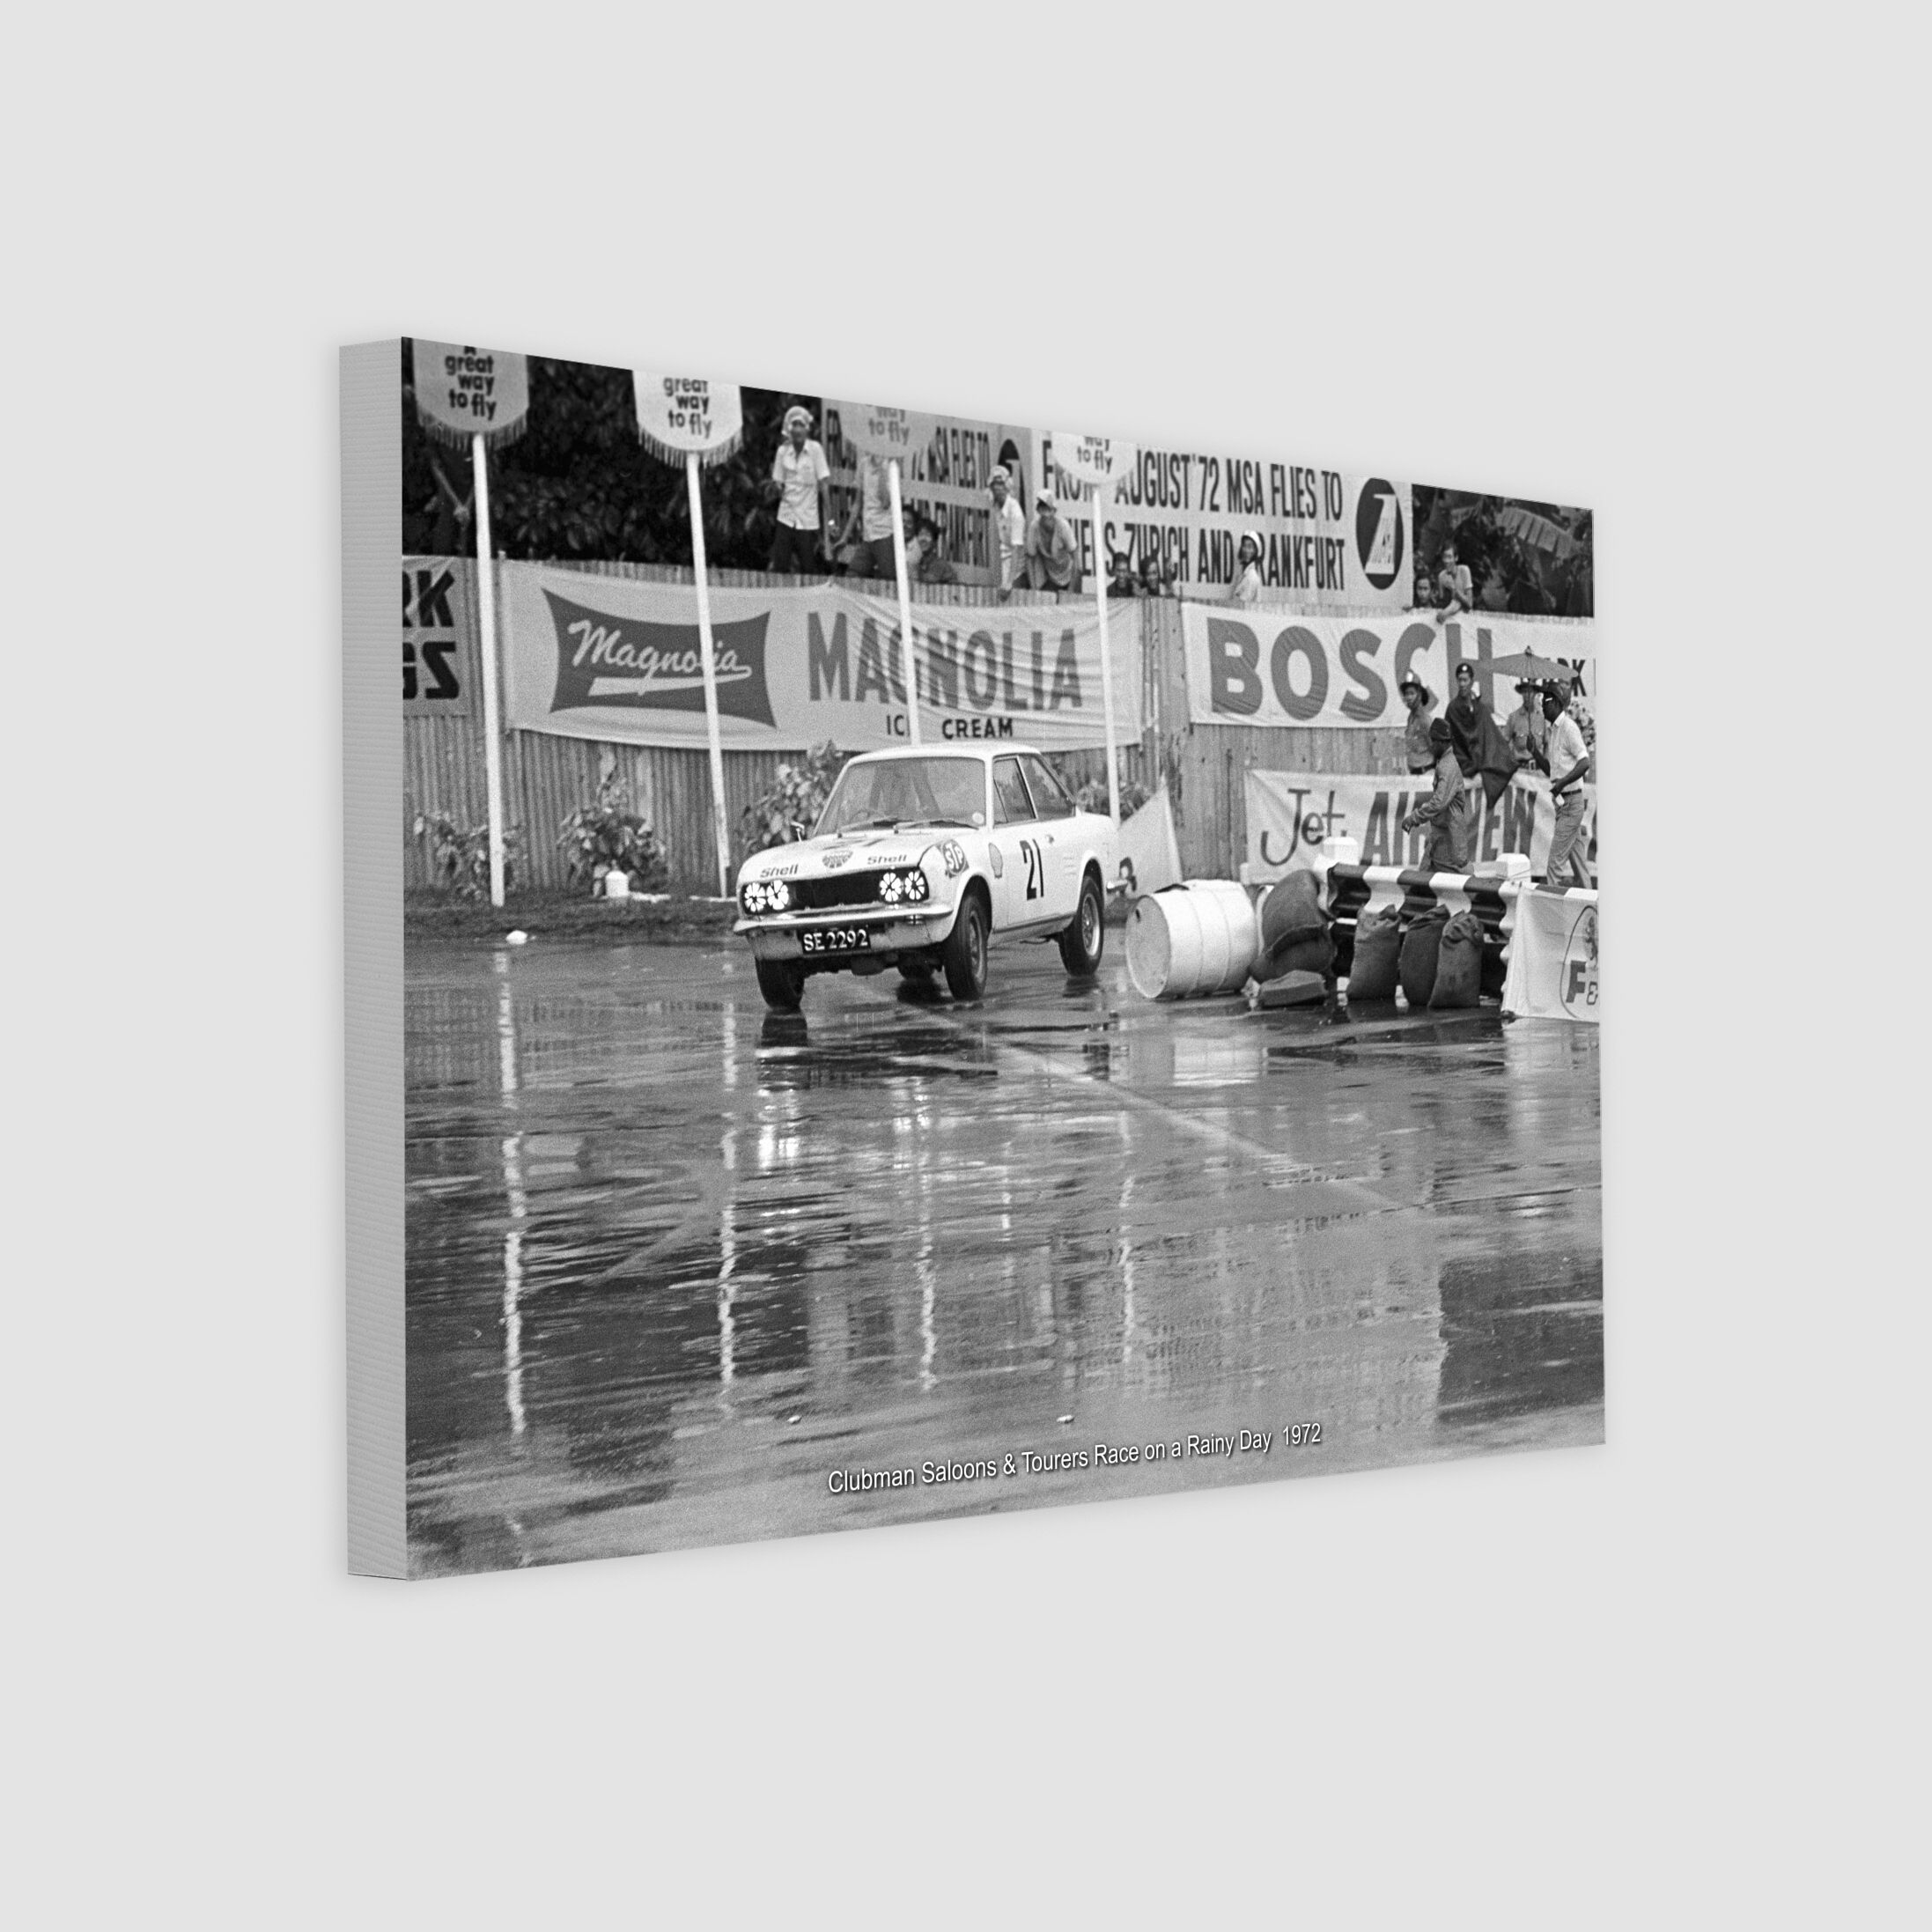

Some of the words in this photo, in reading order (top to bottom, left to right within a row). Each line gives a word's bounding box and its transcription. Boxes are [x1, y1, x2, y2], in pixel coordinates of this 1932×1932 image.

[445, 355, 494, 376] great
[458, 374, 495, 396] way
[663, 377, 709, 397] great
[448, 388, 468, 409] to
[471, 393, 497, 421] fly
[675, 395, 709, 416] way
[668, 409, 685, 428] to
[689, 412, 712, 439] fly
[869, 418, 884, 435] to
[889, 421, 910, 446] fly
[1077, 446, 1091, 462] to
[1095, 449, 1113, 474] fly
[1227, 458, 1265, 515] MSA
[1271, 463, 1317, 520] FLIES
[1321, 470, 1343, 521] TO
[1198, 528, 1234, 585] AND
[1256, 532, 1345, 591] RANKFURT
[568, 619, 748, 696] Magnoia
[807, 612, 1083, 711] MAGNOLIA
[1206, 616, 1495, 722] BOSCH
[886, 714, 911, 738] IC
[941, 717, 1014, 741] CREAM
[867, 854, 908, 866] Shell
[944, 841, 965, 871] STP
[1019, 838, 1044, 901] 21
[760, 864, 799, 879] Shell
[803, 933, 825, 952] SE
[826, 928, 868, 949] 2292
